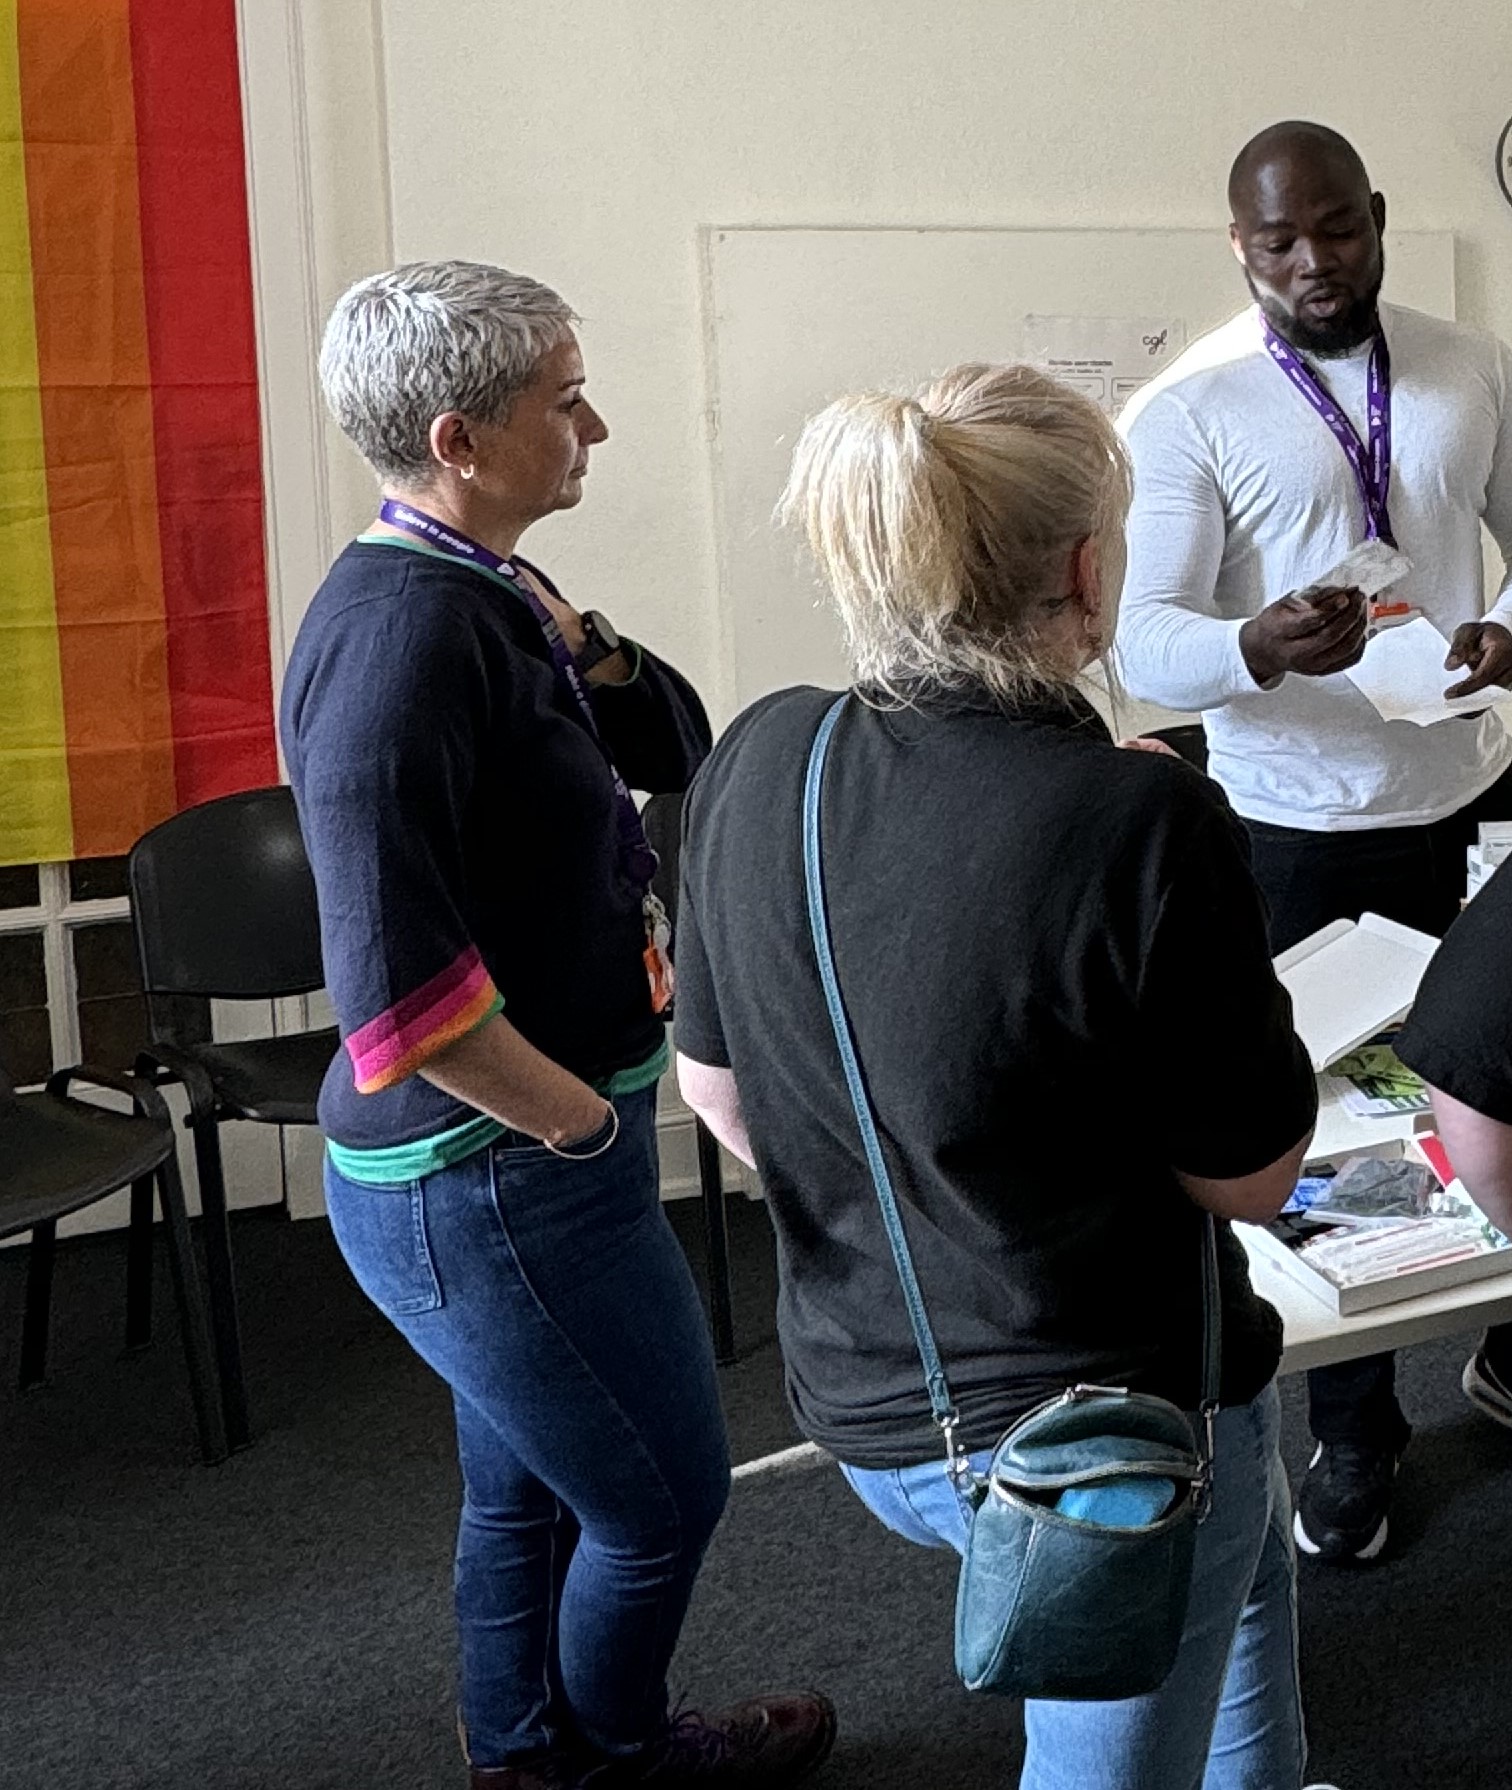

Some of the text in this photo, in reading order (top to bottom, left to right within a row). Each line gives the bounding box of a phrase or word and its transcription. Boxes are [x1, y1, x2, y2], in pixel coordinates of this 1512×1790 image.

[1142, 329, 1168, 355] cgl
[427, 525, 440, 536] in
[438, 532, 475, 553] people
